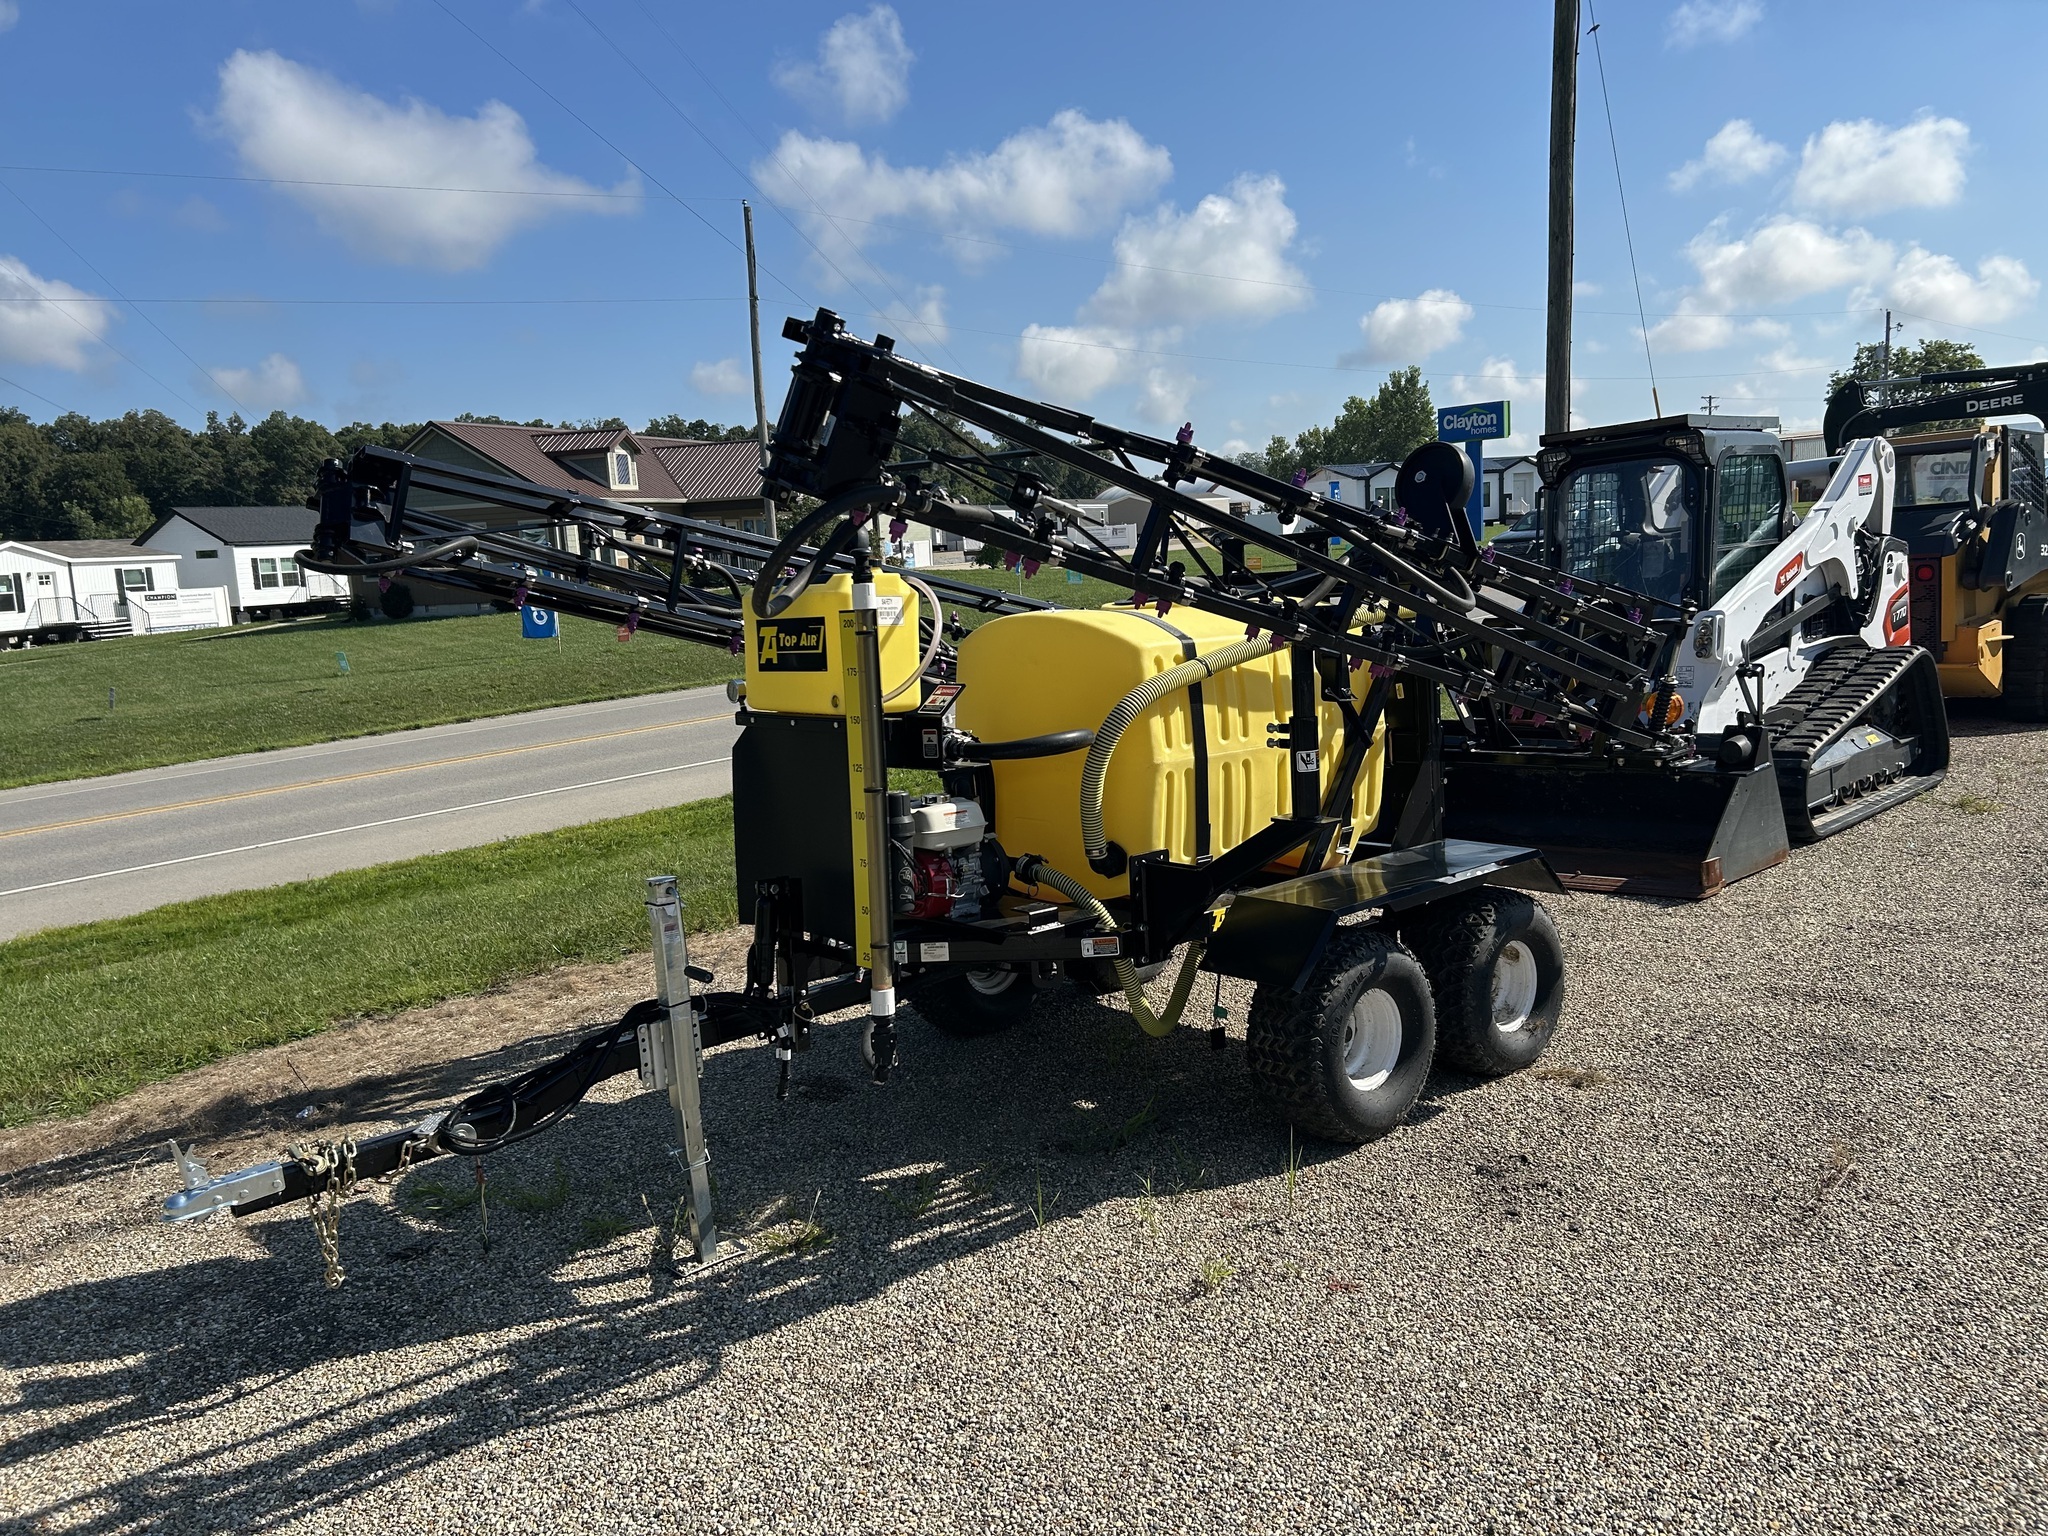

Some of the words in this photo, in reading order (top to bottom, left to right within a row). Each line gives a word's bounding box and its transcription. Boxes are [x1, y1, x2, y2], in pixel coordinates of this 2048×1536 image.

[1966, 394, 2024, 413] DEERE
[1443, 412, 1497, 431] Clayton
[1471, 426, 1497, 435] homes
[1930, 457, 1970, 475] CINTA
[843, 619, 854, 628] 200
[847, 667, 857, 677] 175
[850, 715, 861, 725] 150
[852, 763, 863, 773] 125
[855, 811, 865, 820] 100
[860, 858, 867, 867] 75
[862, 906, 869, 915] 50
[863, 952, 871, 961] 25
